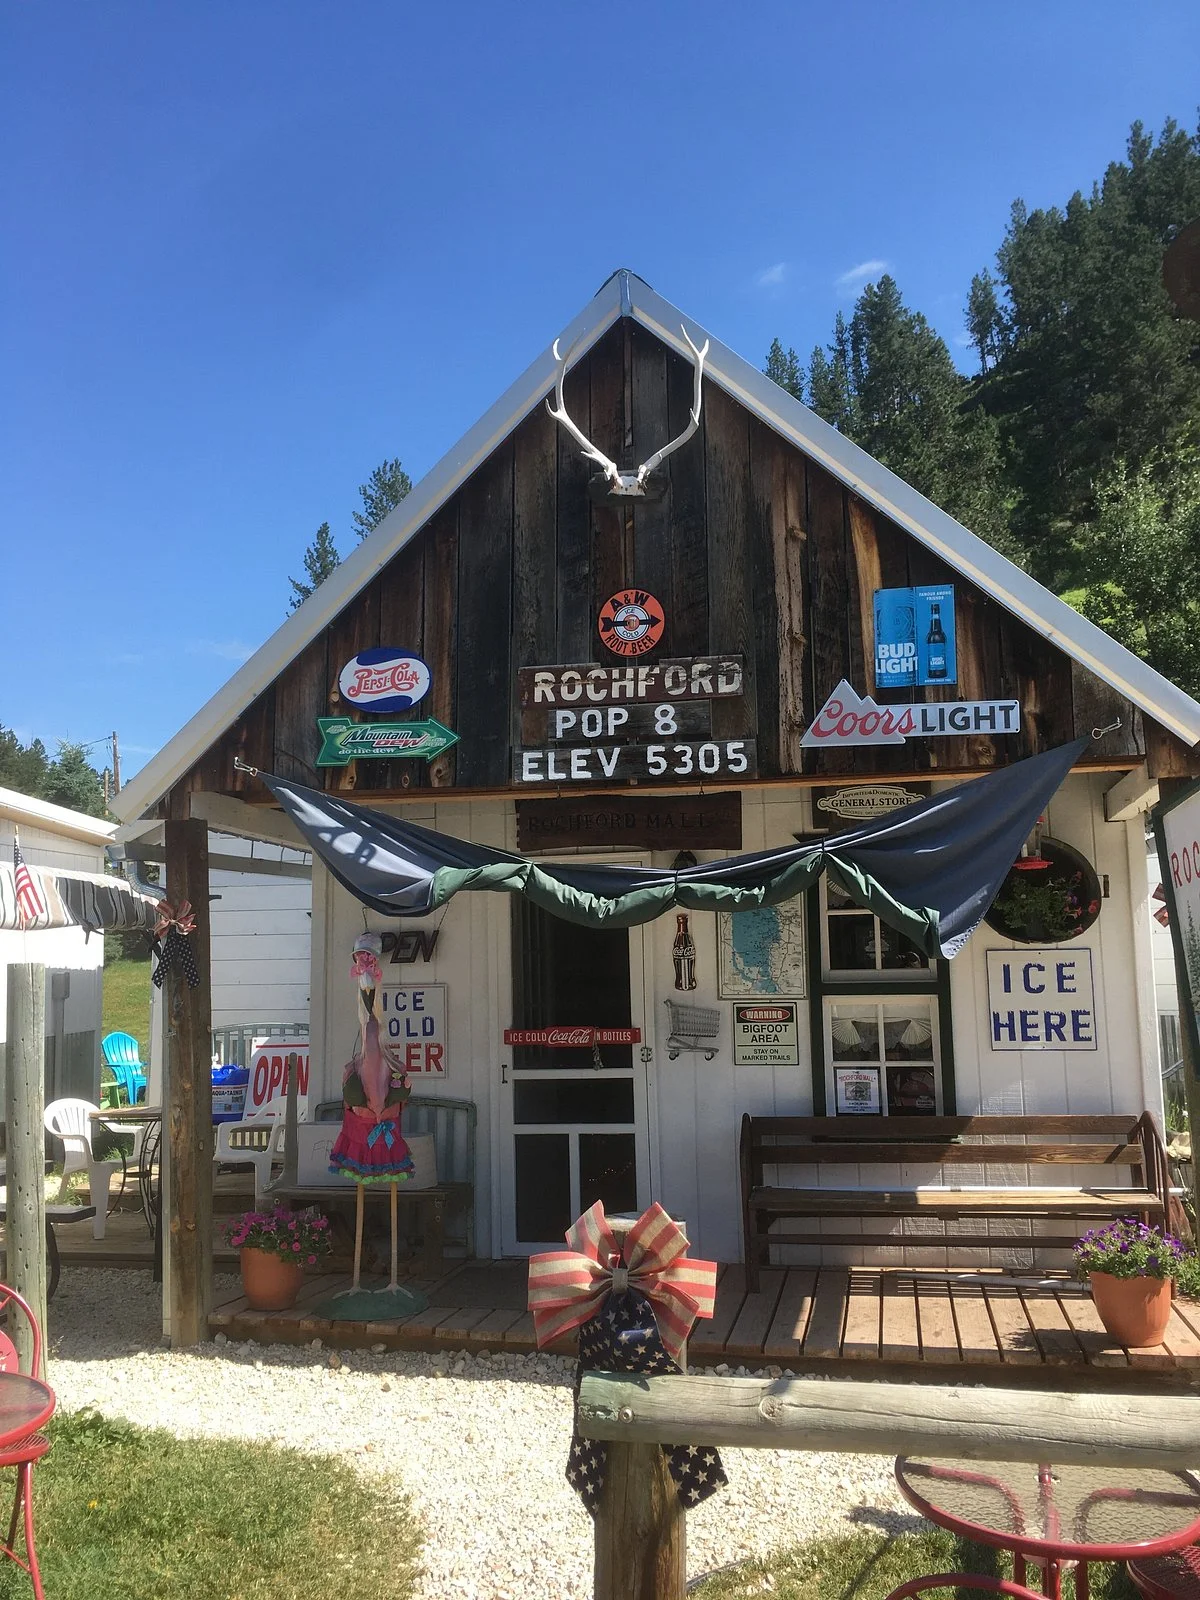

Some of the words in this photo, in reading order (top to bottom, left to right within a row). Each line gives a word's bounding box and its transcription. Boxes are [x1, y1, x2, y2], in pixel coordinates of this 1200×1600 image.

[605, 634, 628, 653] ROOT
[631, 635, 655, 654] BEER
[878, 642, 915, 658] BUD
[875, 656, 918, 673] LIGHT
[534, 662, 742, 702] ROCHFORD
[556, 707, 629, 738] POP
[654, 704, 678, 735] 8
[811, 700, 917, 737] Coors
[921, 705, 1016, 732] LIGHT
[340, 727, 412, 746] Mountain
[522, 747, 621, 781] ELEV
[646, 742, 748, 775] 5305
[831, 798, 878, 807] GENERAL
[878, 797, 912, 806] STORE
[528, 812, 637, 831] ROCHFORD
[647, 812, 713, 828] MALL
[381, 930, 439, 964] PEN
[1001, 962, 1078, 994] ICE
[382, 991, 425, 1011] ICE
[746, 1011, 783, 1019] WARNING
[388, 1016, 435, 1037] OLD
[743, 1024, 789, 1033] BIGFOOT
[992, 1009, 1093, 1042] HERE
[510, 1032, 523, 1042] ICE
[525, 1032, 547, 1042] COLD
[548, 1028, 592, 1045] Coca-Cola
[603, 1031, 631, 1041] BOTTLES
[751, 1034, 780, 1043] AREA
[386, 1042, 444, 1072] ER
